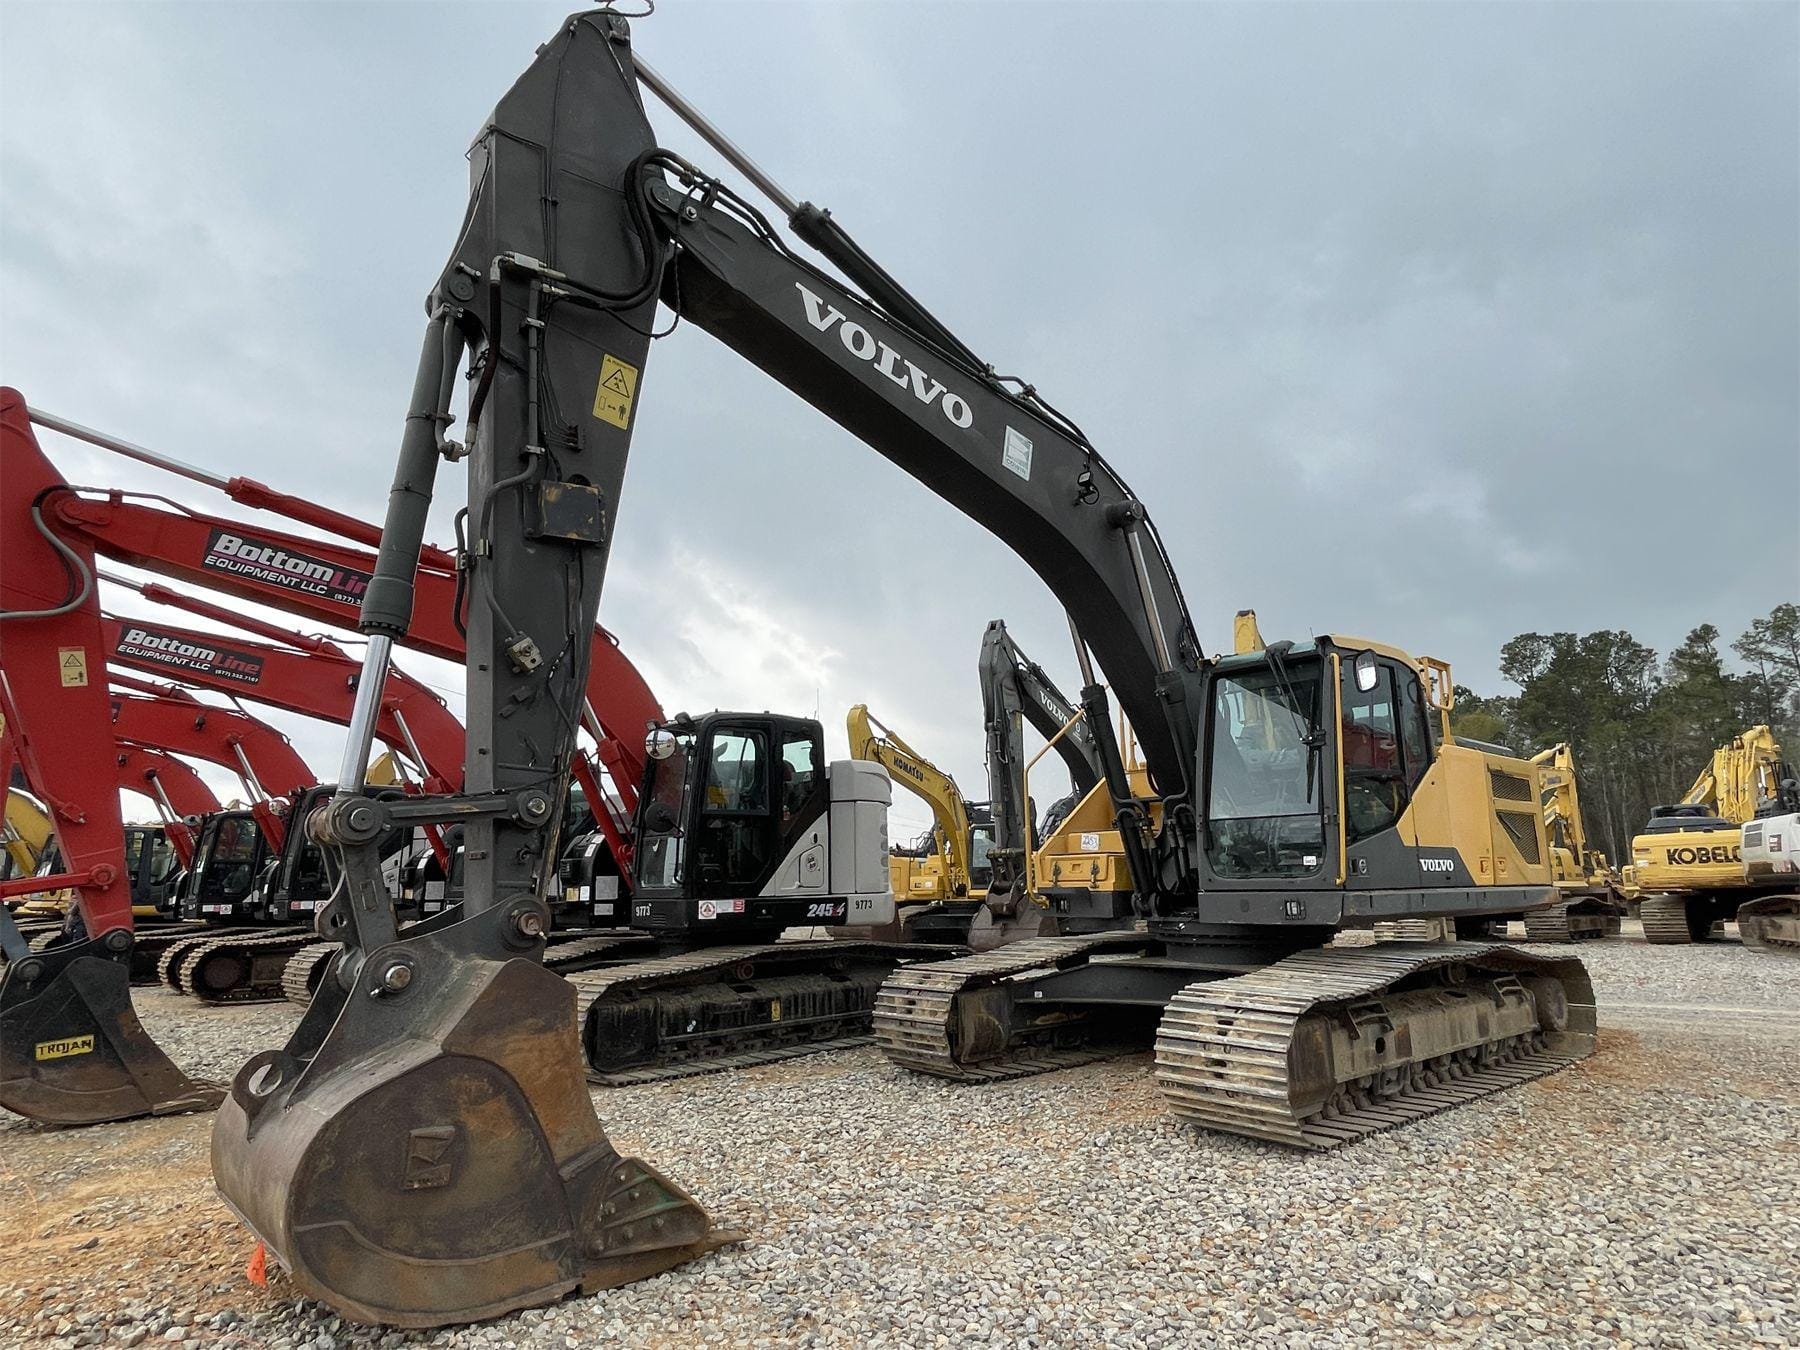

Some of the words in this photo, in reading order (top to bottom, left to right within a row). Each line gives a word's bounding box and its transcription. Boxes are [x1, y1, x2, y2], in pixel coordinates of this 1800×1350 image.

[795, 281, 973, 429] VOLVO
[204, 555, 300, 587] EQUIPMENT
[300, 580, 328, 594] LLC
[212, 533, 369, 594] BottomLin
[117, 644, 189, 667] EQUIPMENT
[189, 660, 211, 671] LLC
[1040, 690, 1069, 725] VOLVO
[893, 755, 924, 781] KOMATSU
[1420, 859, 1454, 871] VOLVO
[1666, 845, 1742, 865] KOBELC
[635, 905, 651, 916] 9773
[855, 900, 873, 909] 9773
[38, 1039, 92, 1055] TROJAN
